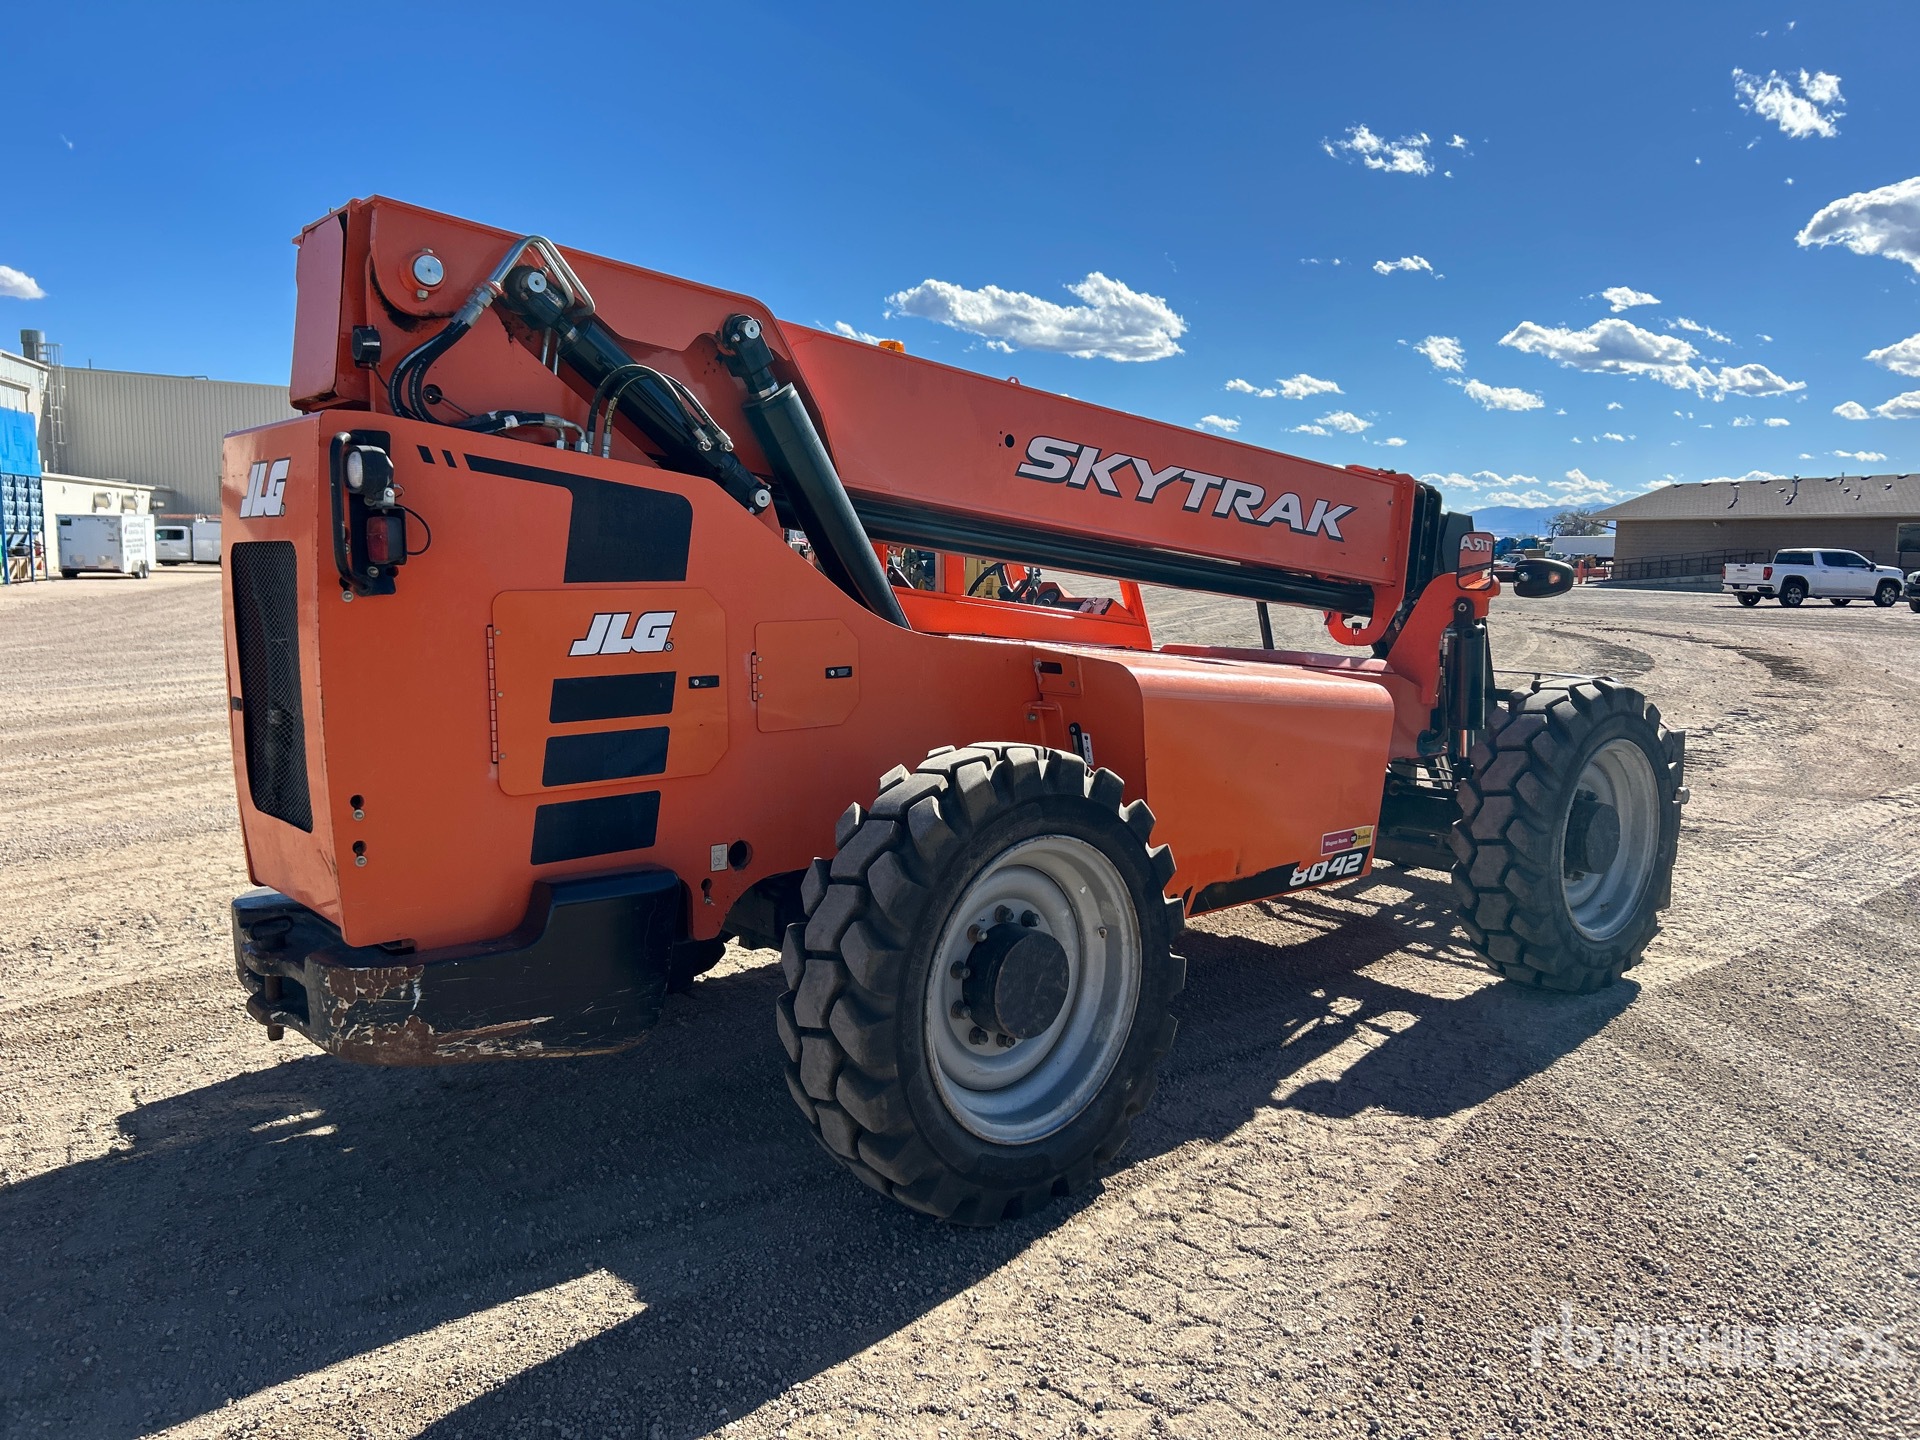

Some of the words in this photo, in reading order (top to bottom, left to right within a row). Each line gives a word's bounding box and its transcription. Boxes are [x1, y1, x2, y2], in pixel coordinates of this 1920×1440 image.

[239, 457, 291, 519] JLG
[1015, 434, 1357, 542] SKYTRAK
[567, 610, 677, 657] JLG
[1289, 852, 1363, 887] 8042
